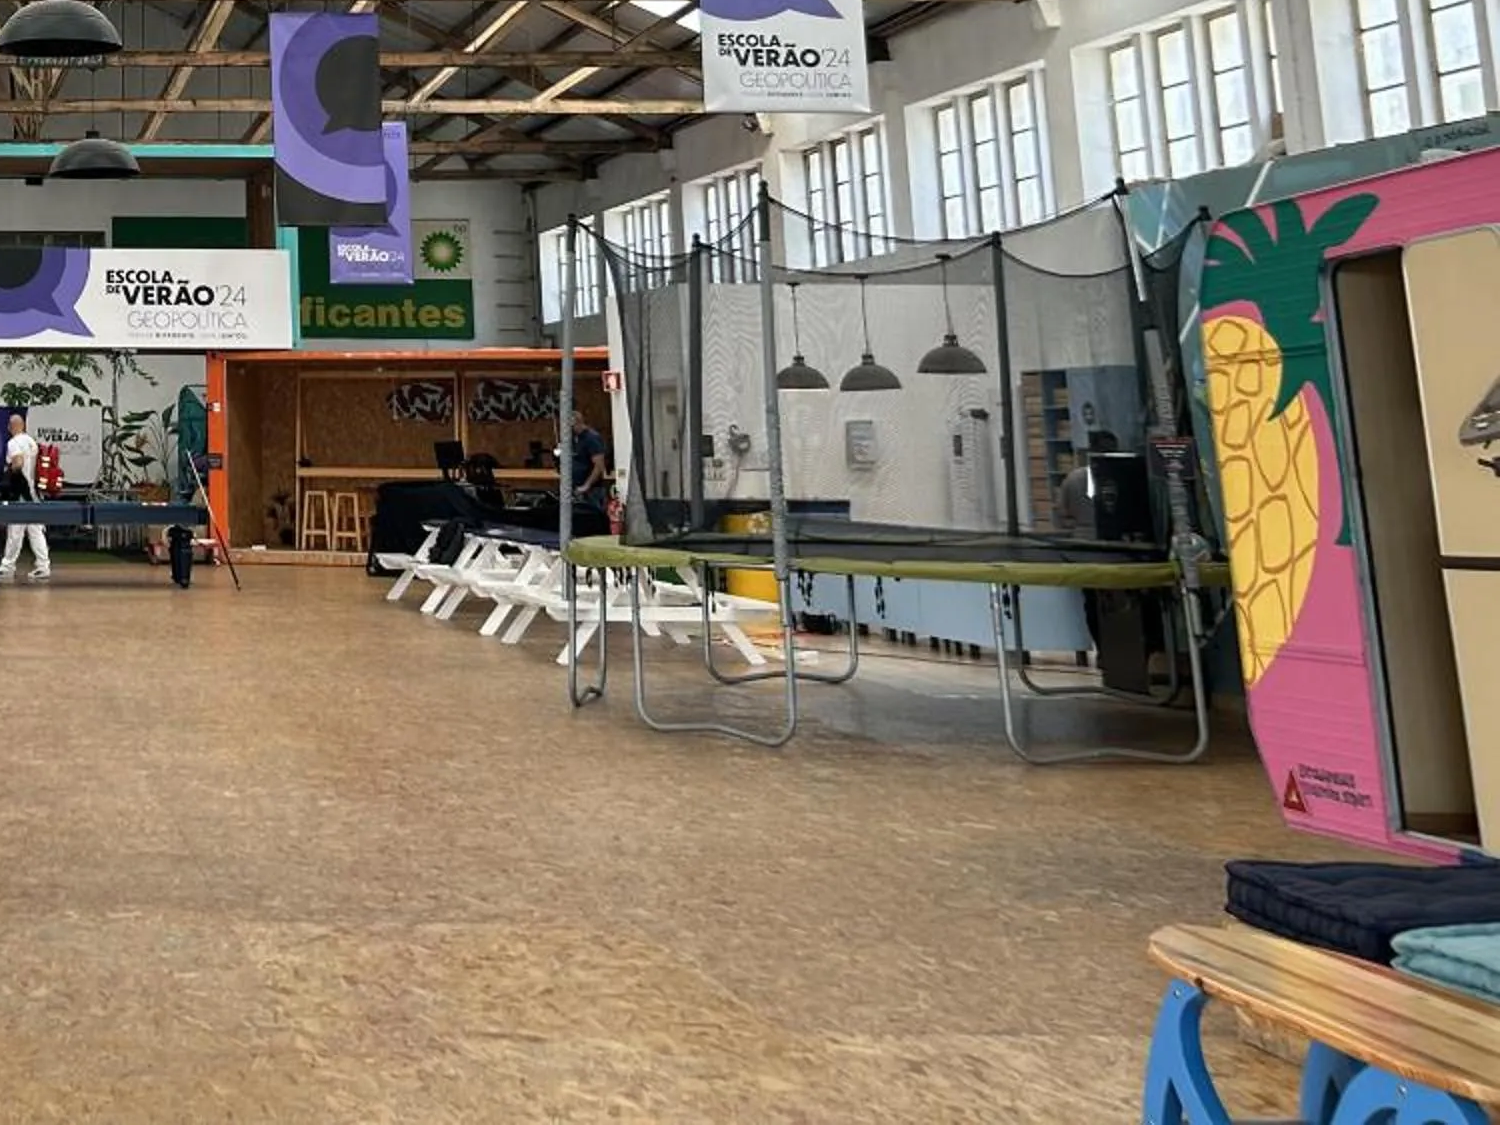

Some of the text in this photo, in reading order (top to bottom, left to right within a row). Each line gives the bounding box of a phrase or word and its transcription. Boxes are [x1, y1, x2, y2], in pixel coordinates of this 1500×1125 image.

[717, 34, 781, 48] ESCOLA
[733, 43, 821, 67] VERÃO
[105, 270, 174, 284] ESCOLA
[105, 285, 121, 294] DE
[122, 280, 215, 306] VERÃO
